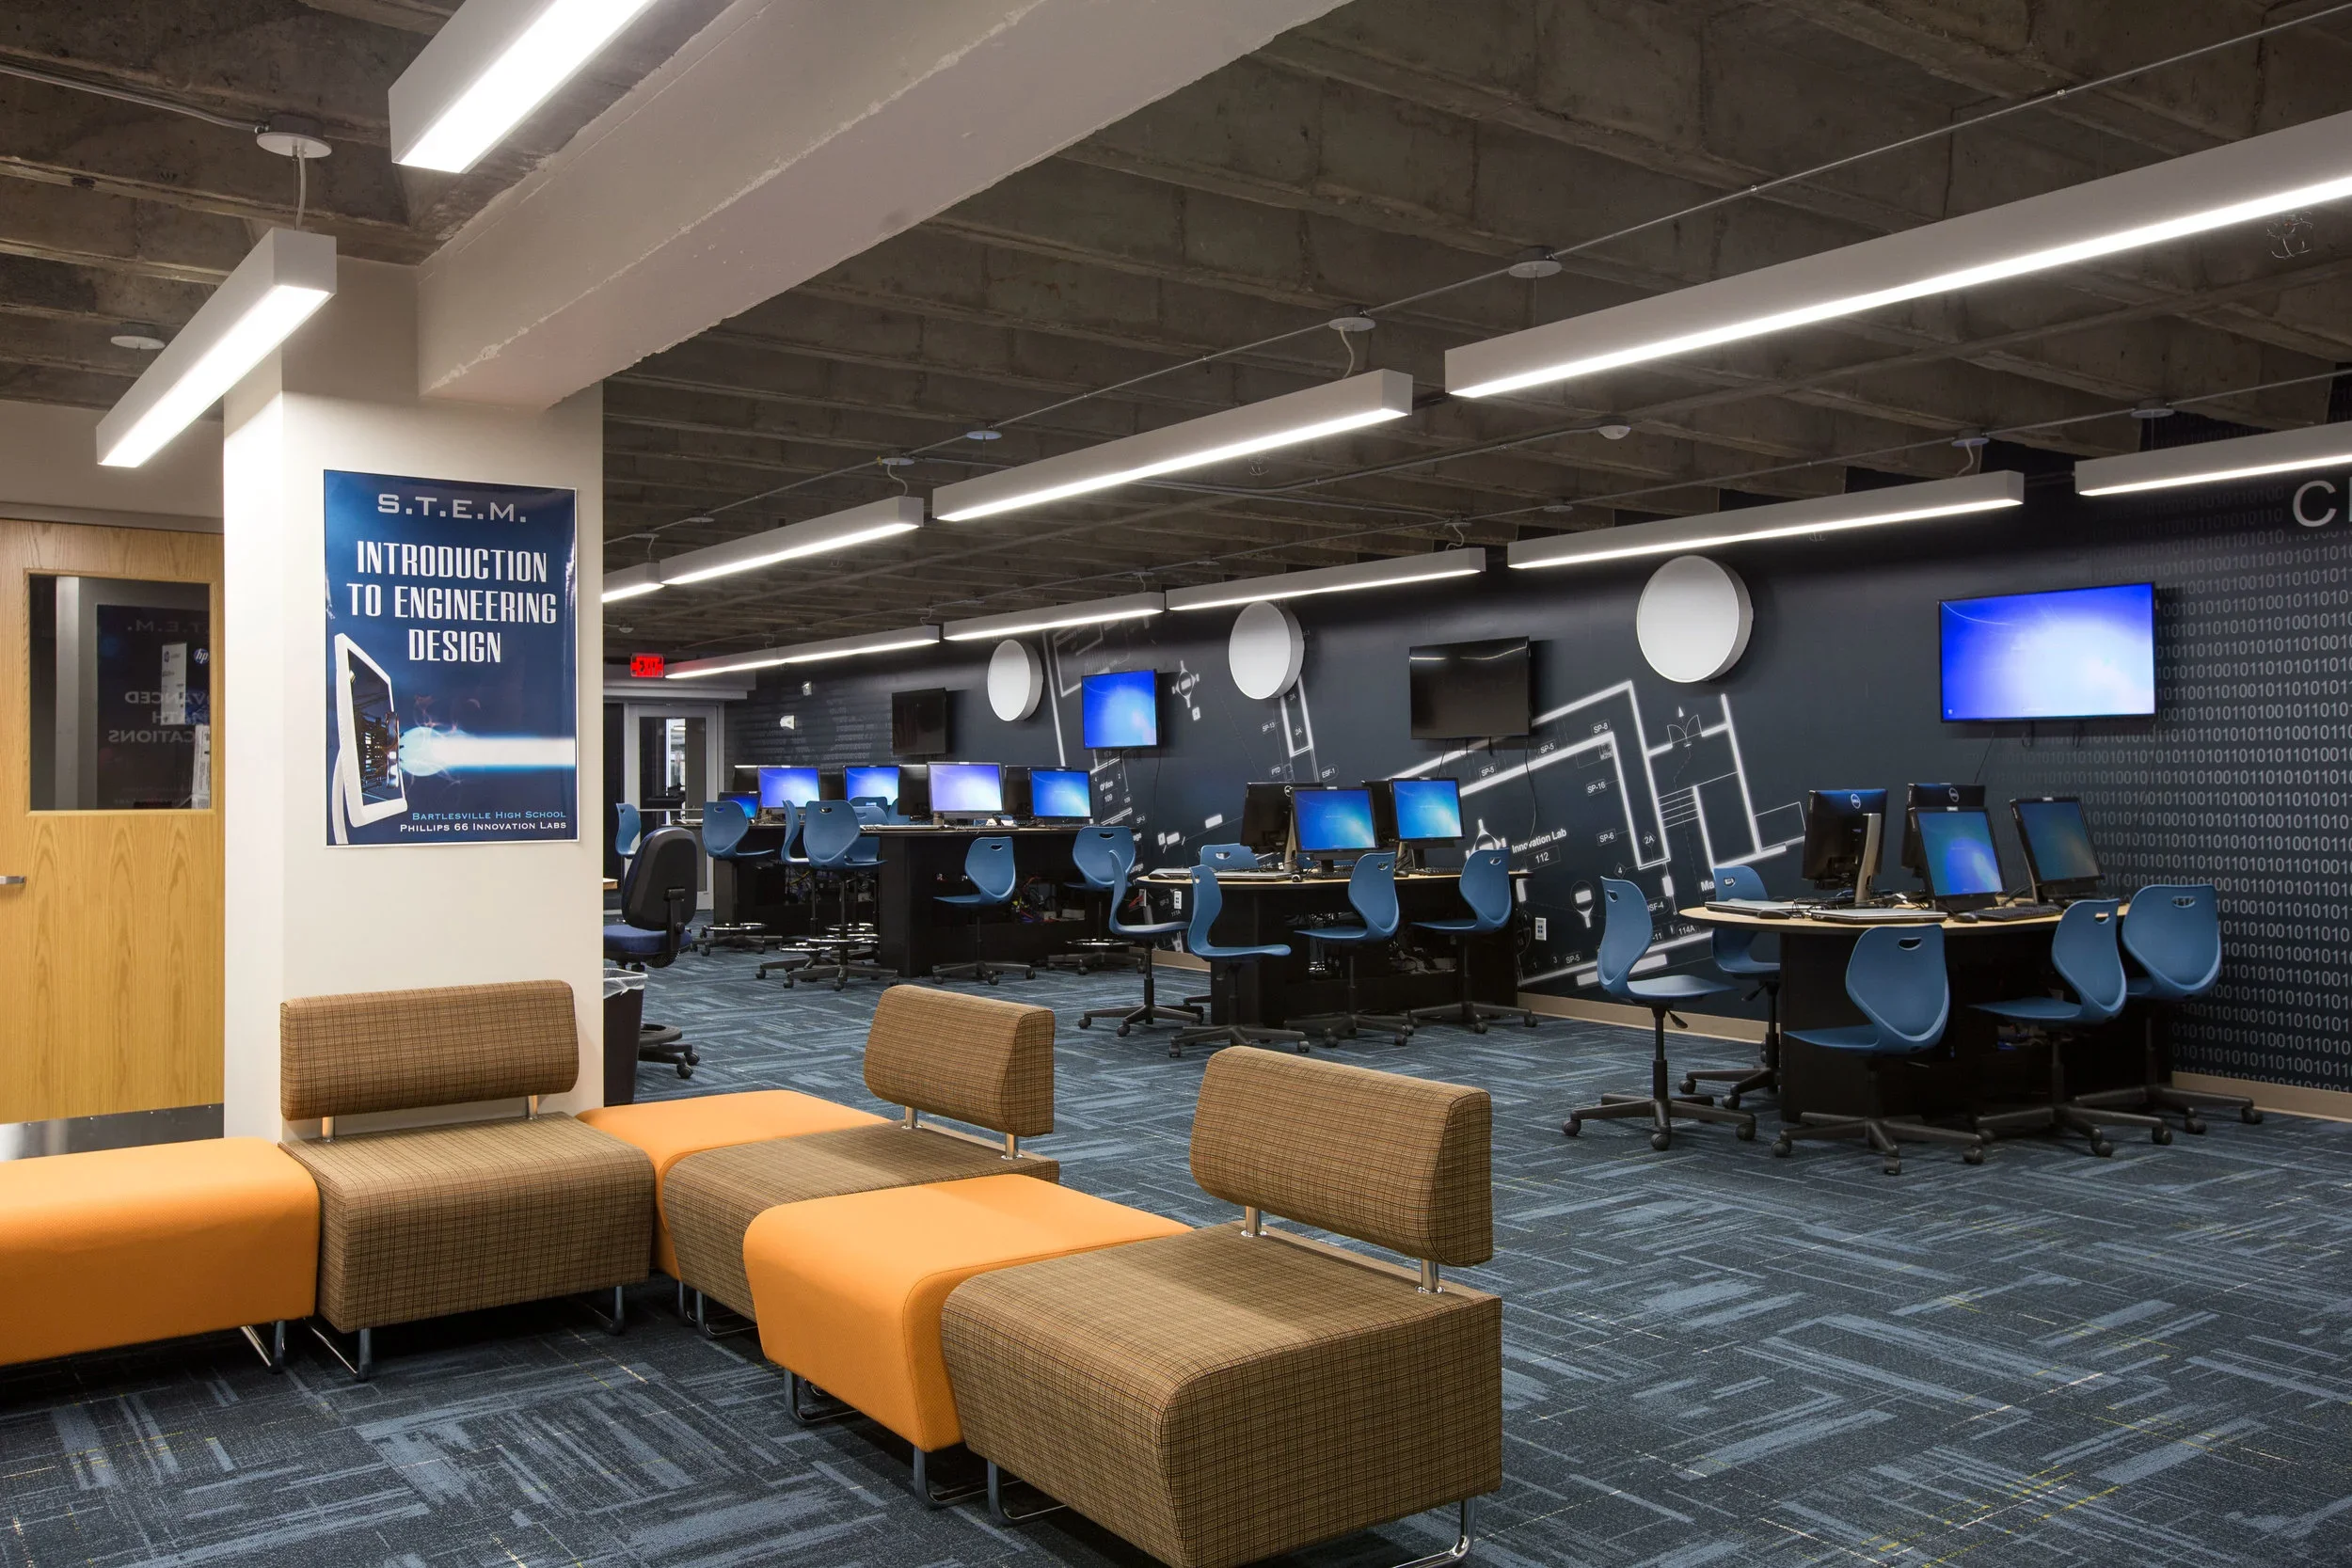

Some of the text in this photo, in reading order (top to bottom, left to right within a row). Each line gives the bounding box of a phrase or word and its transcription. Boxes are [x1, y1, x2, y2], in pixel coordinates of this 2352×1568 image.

[378, 493, 527, 523] S.T.E.M.
[2293, 480, 2352, 528] C
[357, 540, 548, 583] INTRODUCTION
[2157, 565, 2352, 595] 1011001101001011010101
[346, 582, 557, 625] TO ENGINEERING
[2158, 588, 2352, 616] 1001010101101001011010
[408, 628, 501, 664] DESIGN
[195, 648, 209, 664] hp
[2158, 678, 2352, 700] 1011001101001011010101
[2158, 701, 2352, 721] 1001010101101001011010
[1593, 721, 1609, 734] SP-8
[1540, 742, 1555, 754] SP-5
[1481, 766, 1495, 777] SP-5
[1587, 781, 1606, 794] SP-16
[454, 822, 469, 832] 66
[1511, 828, 1567, 854] Innovation Lab
[1599, 832, 1614, 843] SP-6
[1644, 834, 1655, 845] 2A
[1535, 851, 1549, 864] 112
[1700, 879, 1715, 892] Ma
[1647, 901, 1664, 911] SF-4
[2216, 897, 2352, 919] 101001011010101
[1652, 932, 1662, 941] -11
[1678, 925, 1695, 935] 114A
[2217, 919, 2352, 942] 101101001011010
[1565, 954, 1581, 964] SP-5
[2210, 983, 2352, 1009] 001011010101101
